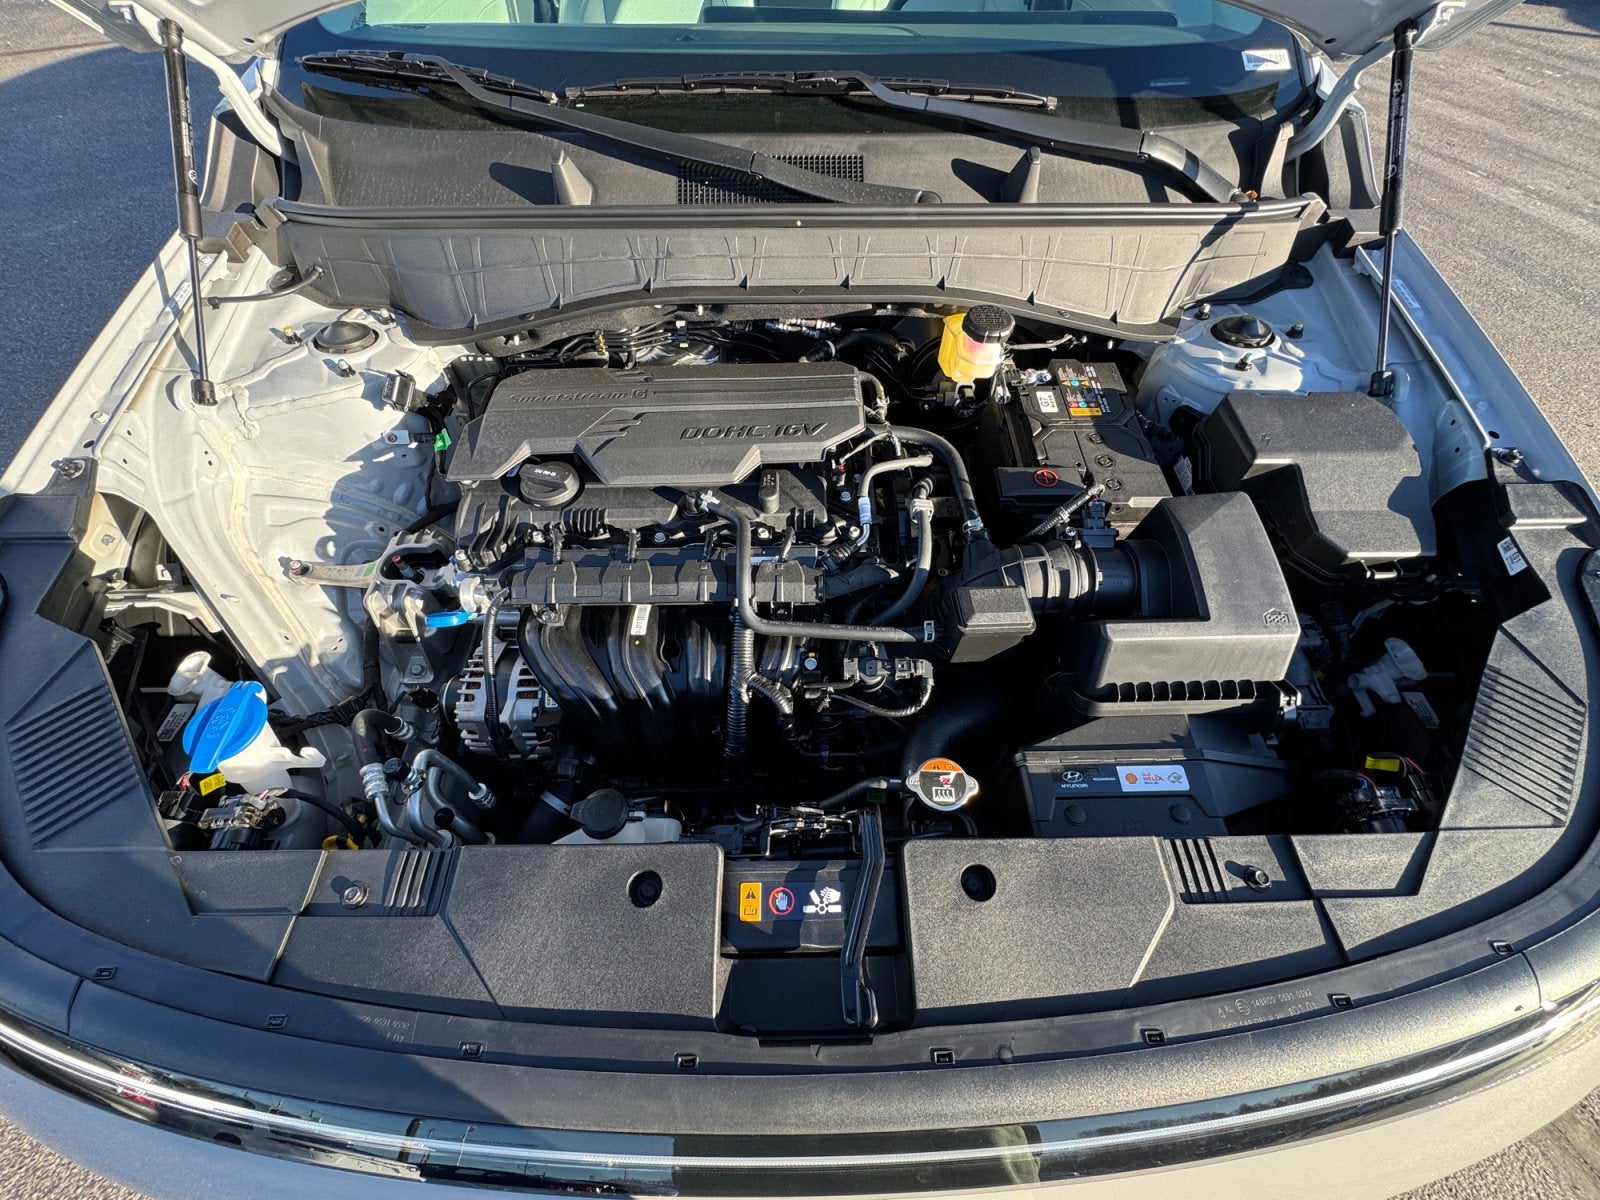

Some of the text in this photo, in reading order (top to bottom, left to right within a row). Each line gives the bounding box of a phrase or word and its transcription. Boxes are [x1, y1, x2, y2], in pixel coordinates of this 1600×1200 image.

[510, 391, 627, 403] Smartstream
[680, 422, 828, 440] DOHC 16V
